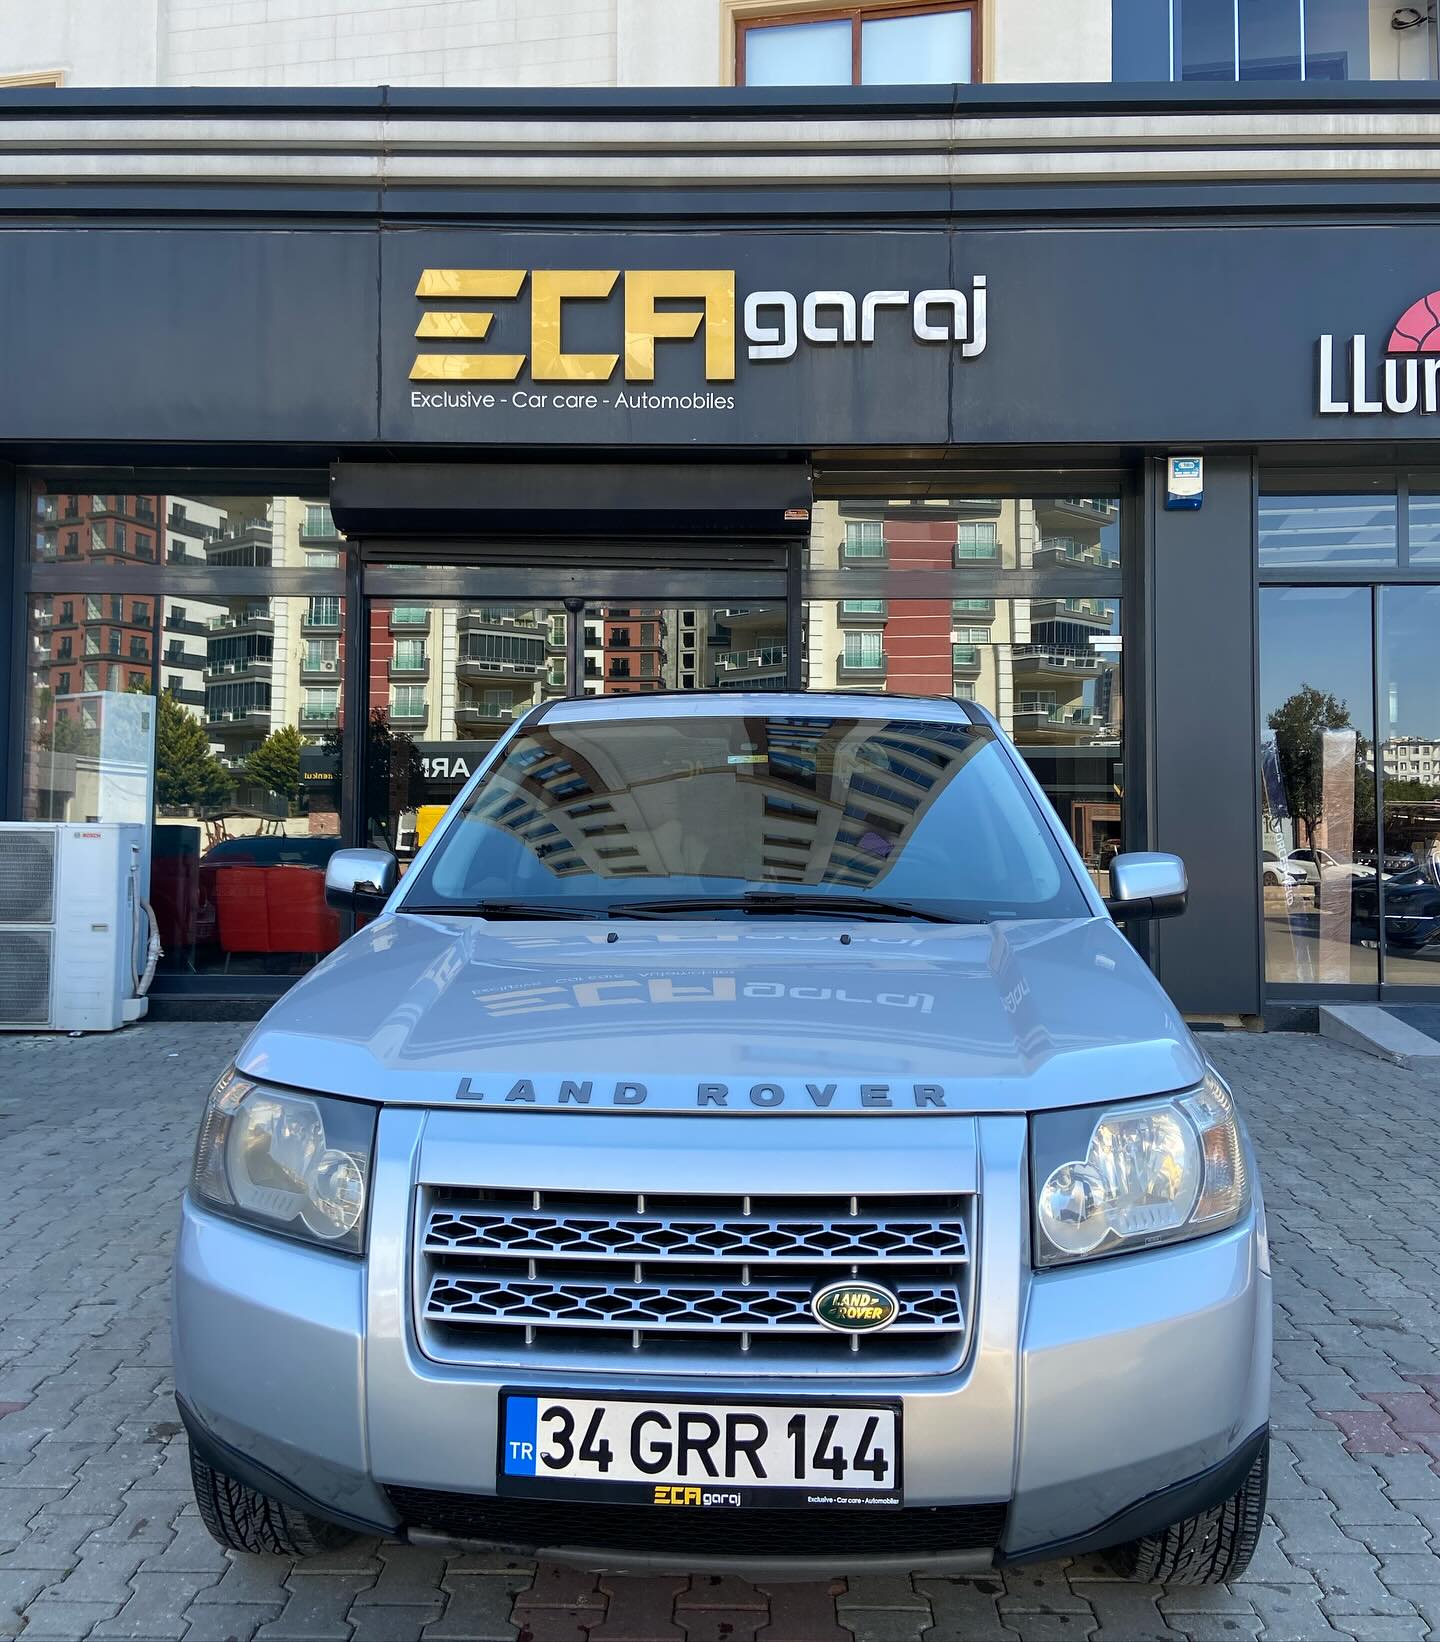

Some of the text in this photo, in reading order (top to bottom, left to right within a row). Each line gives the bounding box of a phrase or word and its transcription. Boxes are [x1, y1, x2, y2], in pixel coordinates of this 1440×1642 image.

[408, 269, 987, 383] ECA garaj
[410, 390, 495, 408] Exclusive
[512, 391, 548, 408] Car
[552, 395, 598, 408] care
[615, 391, 735, 409] Automobiles
[455, 1076, 948, 1108] LAND ROVER
[509, 1405, 889, 1481] TR 34 GRR 144
[703, 1493, 741, 1506] garaj
